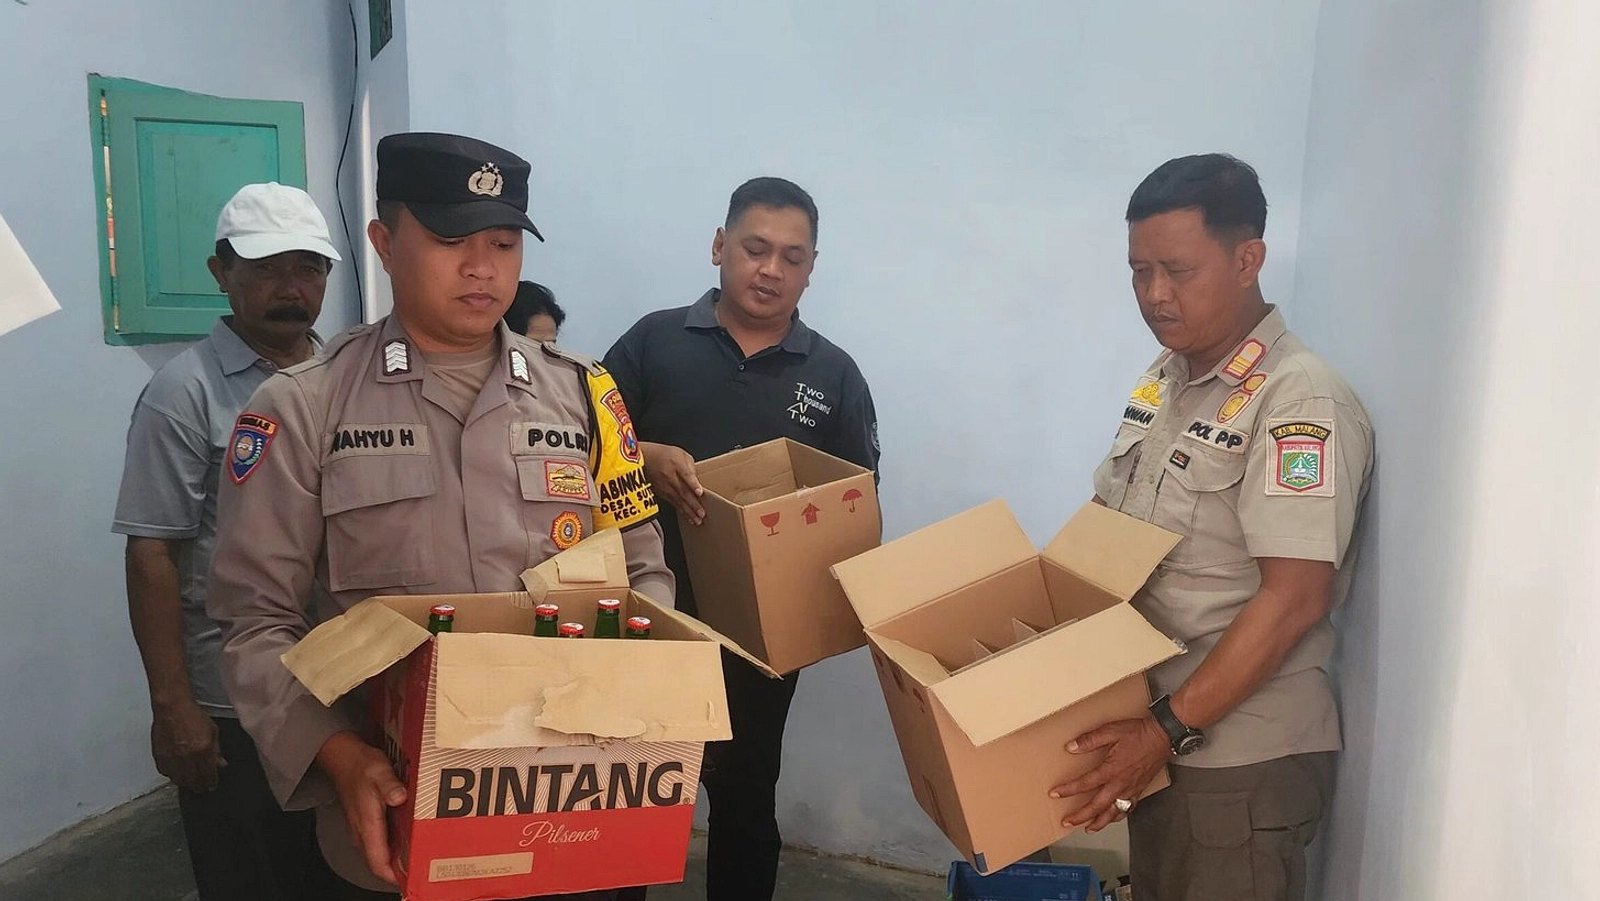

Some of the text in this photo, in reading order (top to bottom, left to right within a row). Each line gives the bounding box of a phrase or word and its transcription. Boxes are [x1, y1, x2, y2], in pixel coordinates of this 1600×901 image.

[399, 428, 414, 447] H
[1188, 421, 1243, 449] POL PP
[1294, 425, 1326, 439] MALANG
[600, 496, 632, 514] DESA
[613, 505, 641, 521] KEC.
[436, 762, 684, 820] BINTANG
[519, 820, 601, 848] Pilsener
